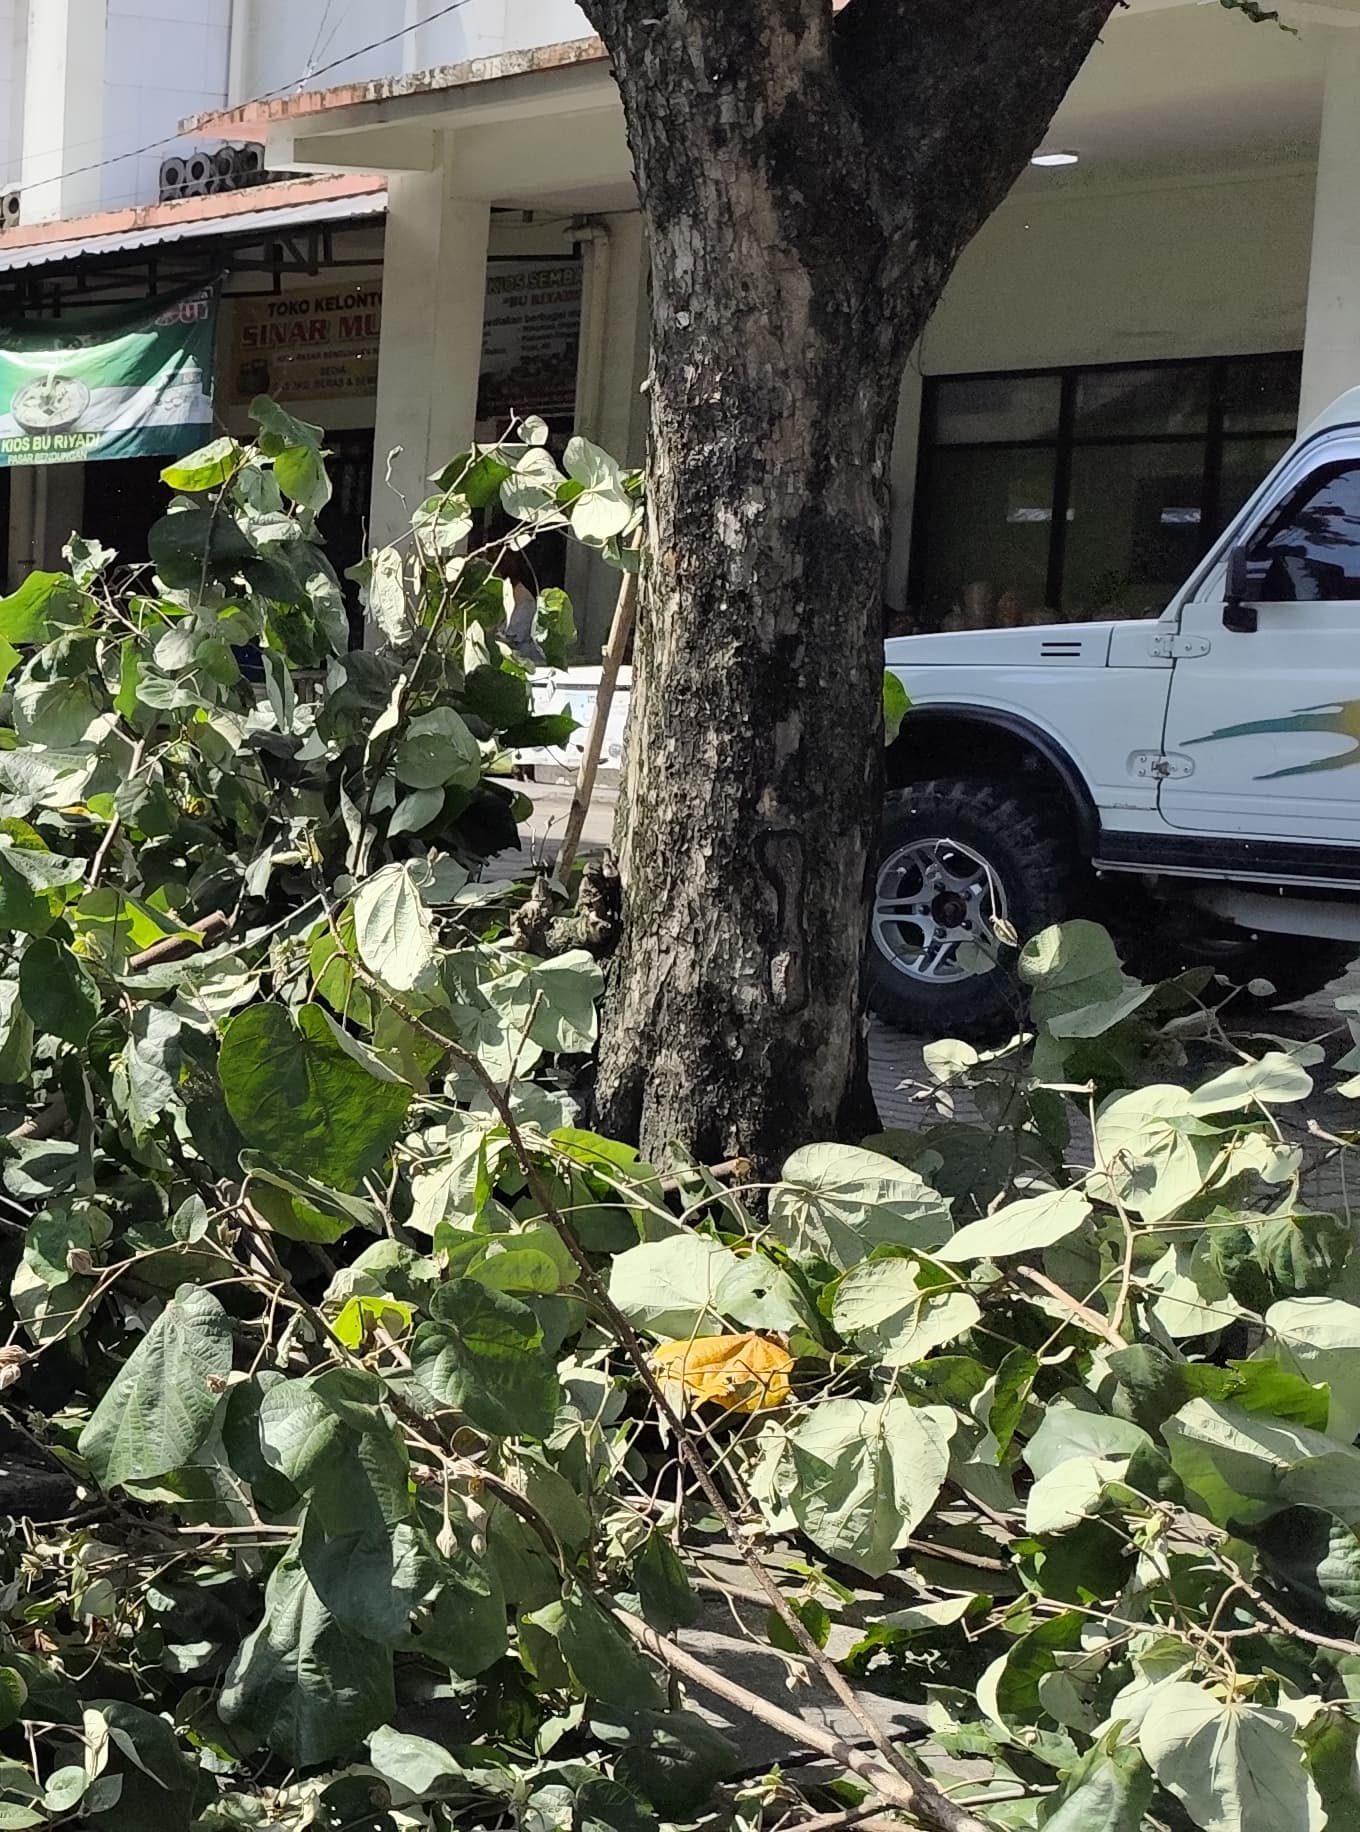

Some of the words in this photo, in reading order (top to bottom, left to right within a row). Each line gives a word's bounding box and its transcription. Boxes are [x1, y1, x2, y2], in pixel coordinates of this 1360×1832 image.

[268, 299, 310, 317] TOKO
[241, 319, 327, 346] SINAR
[338, 314, 381, 338] MU
[1, 437, 30, 453] KIOS
[32, 435, 51, 451] BU
[53, 433, 100, 450] RIYADI
